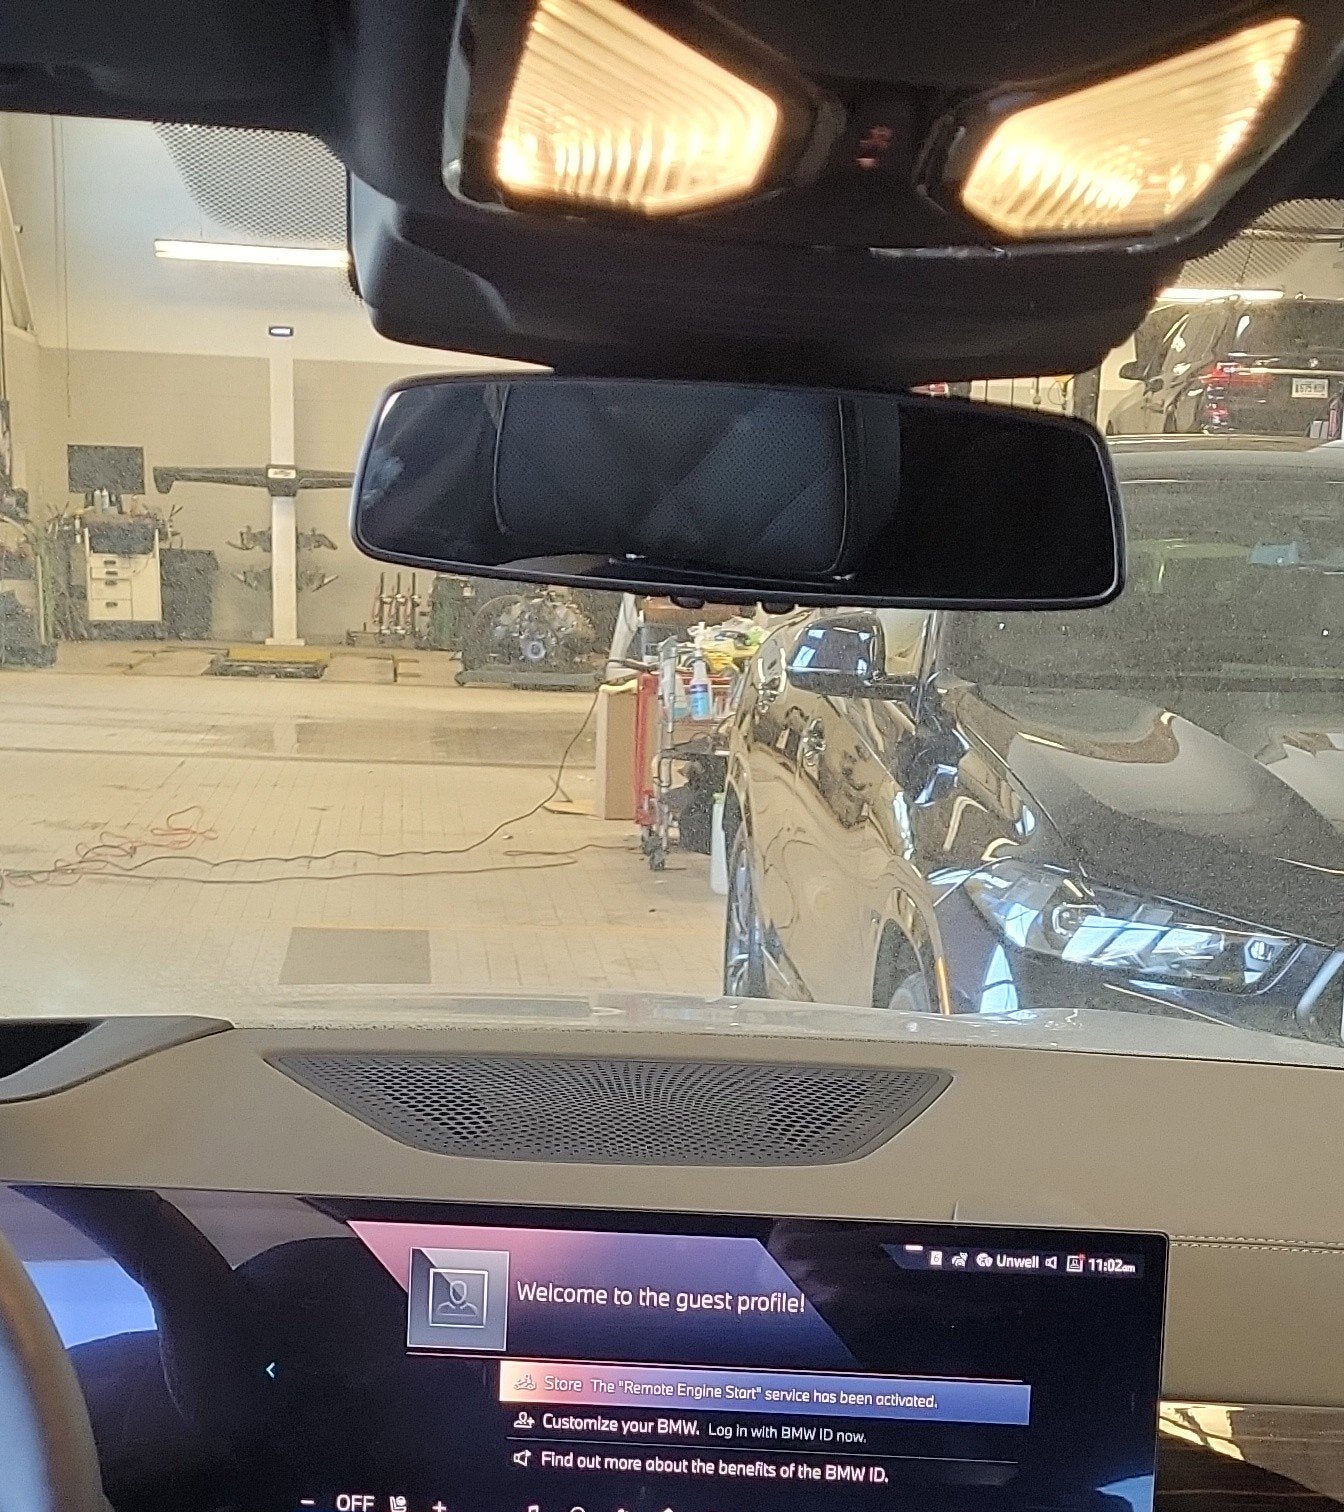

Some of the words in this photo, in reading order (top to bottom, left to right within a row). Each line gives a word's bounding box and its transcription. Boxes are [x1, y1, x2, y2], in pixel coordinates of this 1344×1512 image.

[996, 1254, 1040, 1270] Unwell
[1088, 1258, 1136, 1275] 11:02am
[517, 1281, 607, 1305] Welcome
[614, 1287, 633, 1306] to
[639, 1286, 670, 1307] the
[676, 1291, 732, 1312] guest
[737, 1292, 805, 1315] profile!
[544, 1375, 583, 1392] Store
[591, 1379, 615, 1394] The
[619, 1380, 674, 1397] "Remote
[677, 1383, 722, 1400] Engine
[725, 1385, 762, 1400] Start"
[765, 1388, 810, 1403] service
[813, 1389, 837, 1404] has
[840, 1390, 873, 1406] been
[875, 1392, 939, 1409] activated.
[543, 1413, 618, 1432] Customize
[621, 1420, 654, 1436] your
[657, 1418, 700, 1436] BMW.
[708, 1422, 733, 1439] Log
[736, 1423, 748, 1438] in
[751, 1425, 778, 1439] with
[781, 1426, 816, 1441] BMW
[819, 1427, 834, 1442] ID
[836, 1430, 867, 1444] now.
[541, 1450, 574, 1468] Find
[577, 1453, 601, 1469] out
[604, 1456, 642, 1471] more
[645, 1456, 688, 1473] about
[691, 1458, 715, 1475] the
[718, 1459, 776, 1478] benefits
[779, 1462, 796, 1479] of
[798, 1463, 822, 1480] the
[825, 1464, 866, 1482] BMW
[869, 1466, 889, 1483] ID.
[336, 1493, 375, 1512] OFF
